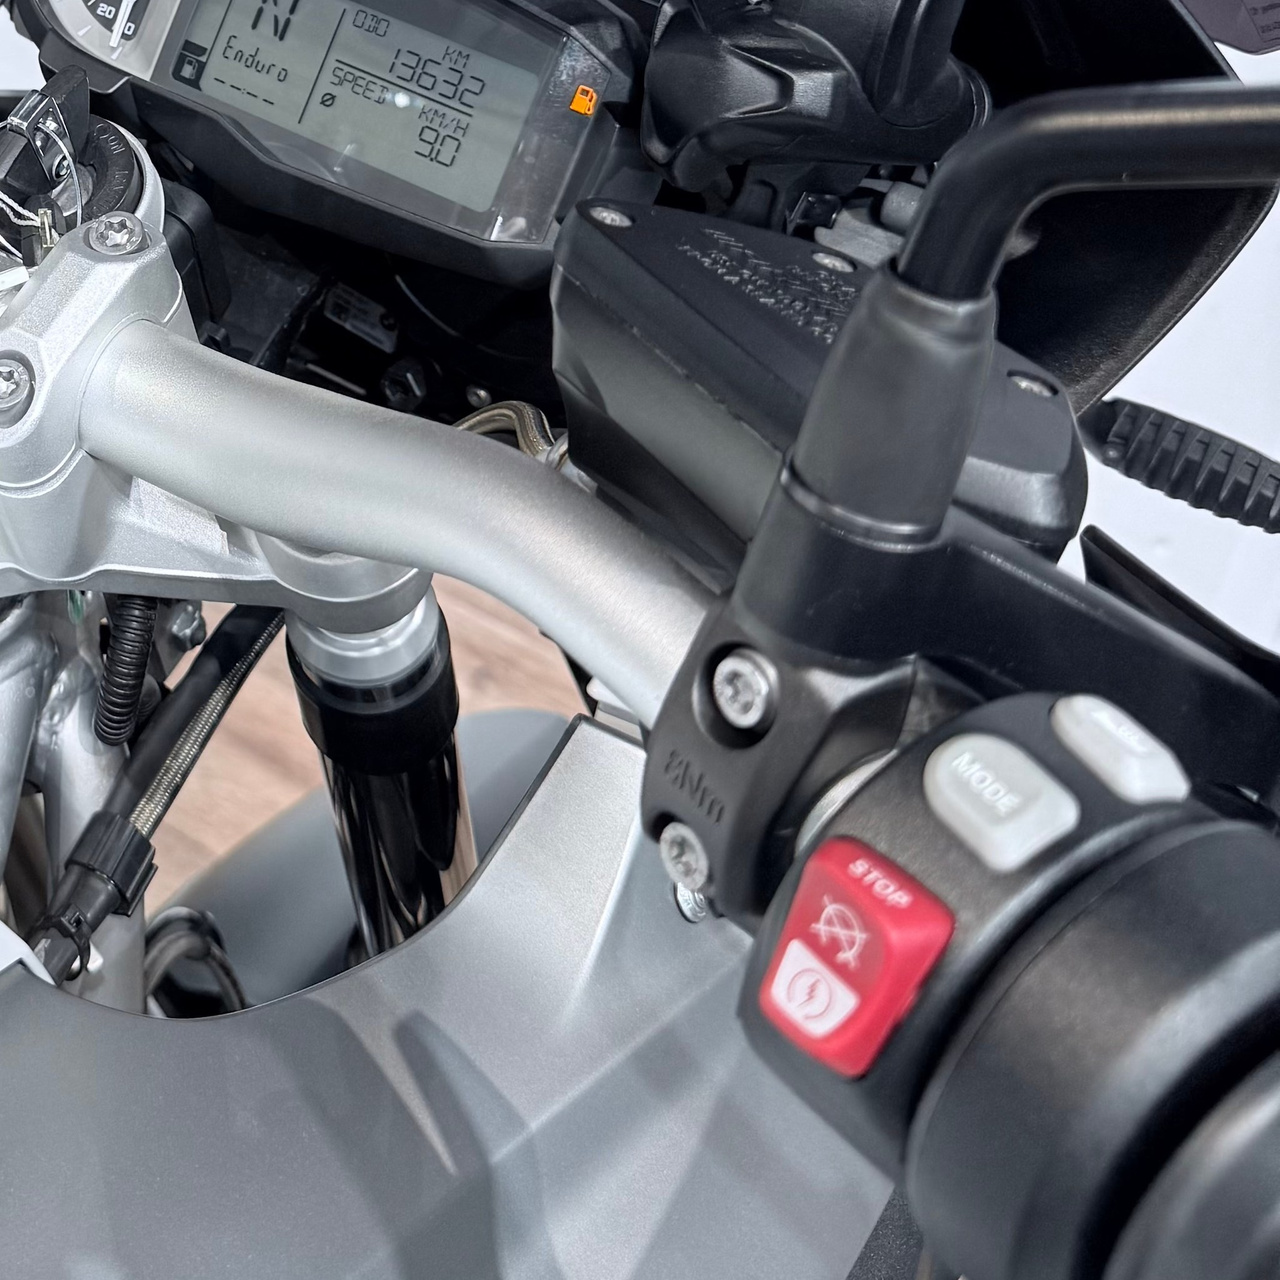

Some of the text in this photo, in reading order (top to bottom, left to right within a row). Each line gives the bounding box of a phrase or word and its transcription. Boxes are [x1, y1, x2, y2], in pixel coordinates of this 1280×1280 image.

[96, 2, 116, 19] 20
[123, 22, 135, 36] 0
[352, 9, 390, 37] ODO
[222, 34, 288, 82] Enduro
[442, 45, 471, 69] KM
[330, 66, 389, 105] SPEED
[389, 48, 486, 109] 13632
[418, 104, 470, 138] KM/H
[414, 125, 462, 168] 9.0
[951, 751, 1023, 817] MODE
[847, 859, 914, 908] STOP
